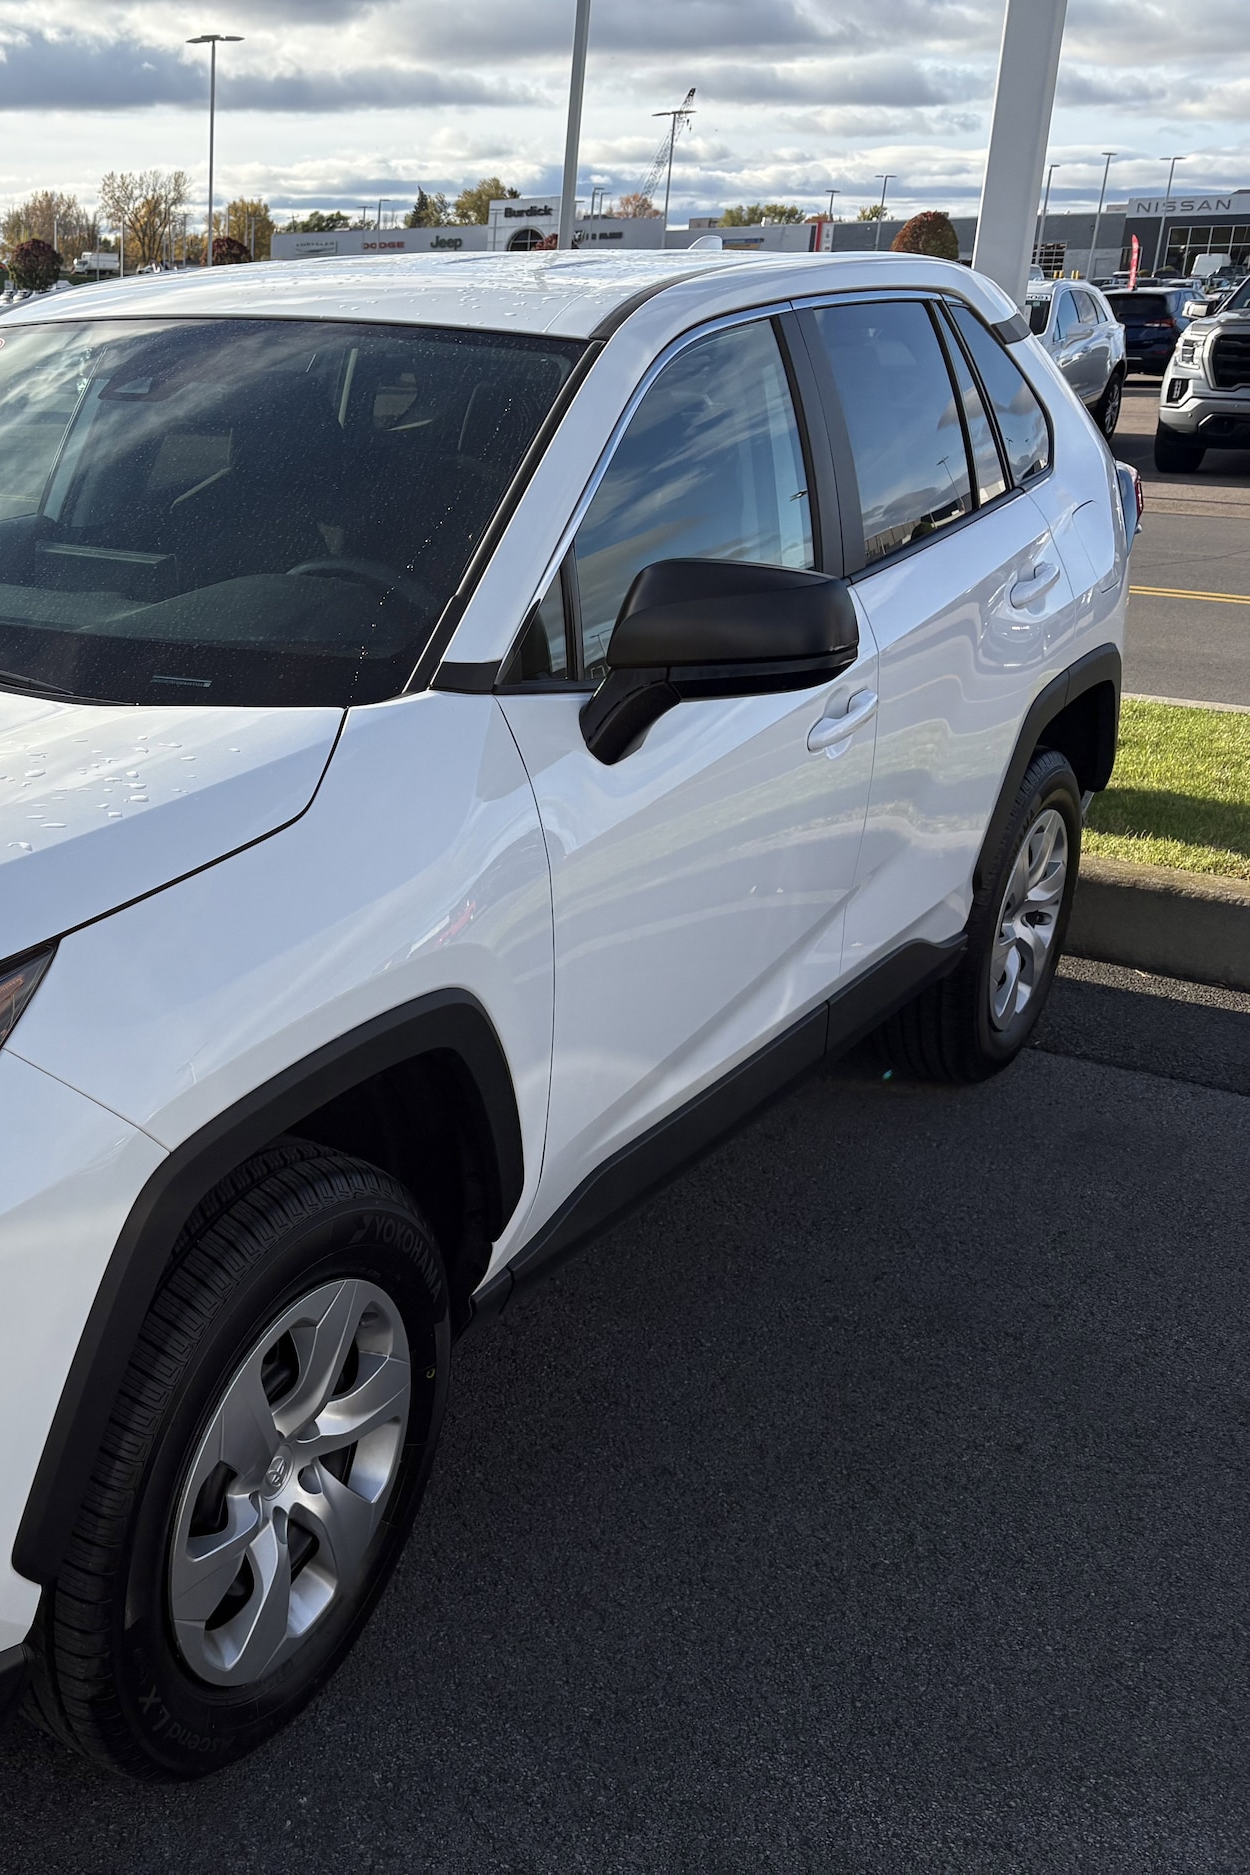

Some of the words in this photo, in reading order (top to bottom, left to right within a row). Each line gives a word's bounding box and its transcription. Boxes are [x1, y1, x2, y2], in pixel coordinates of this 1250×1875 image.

[504, 205, 553, 218] Burdick
[1136, 199, 1232, 213] NISSAN
[363, 241, 405, 250] DODGE
[430, 235, 463, 250] Jeep
[374, 1215, 442, 1304] YOKOHAMA
